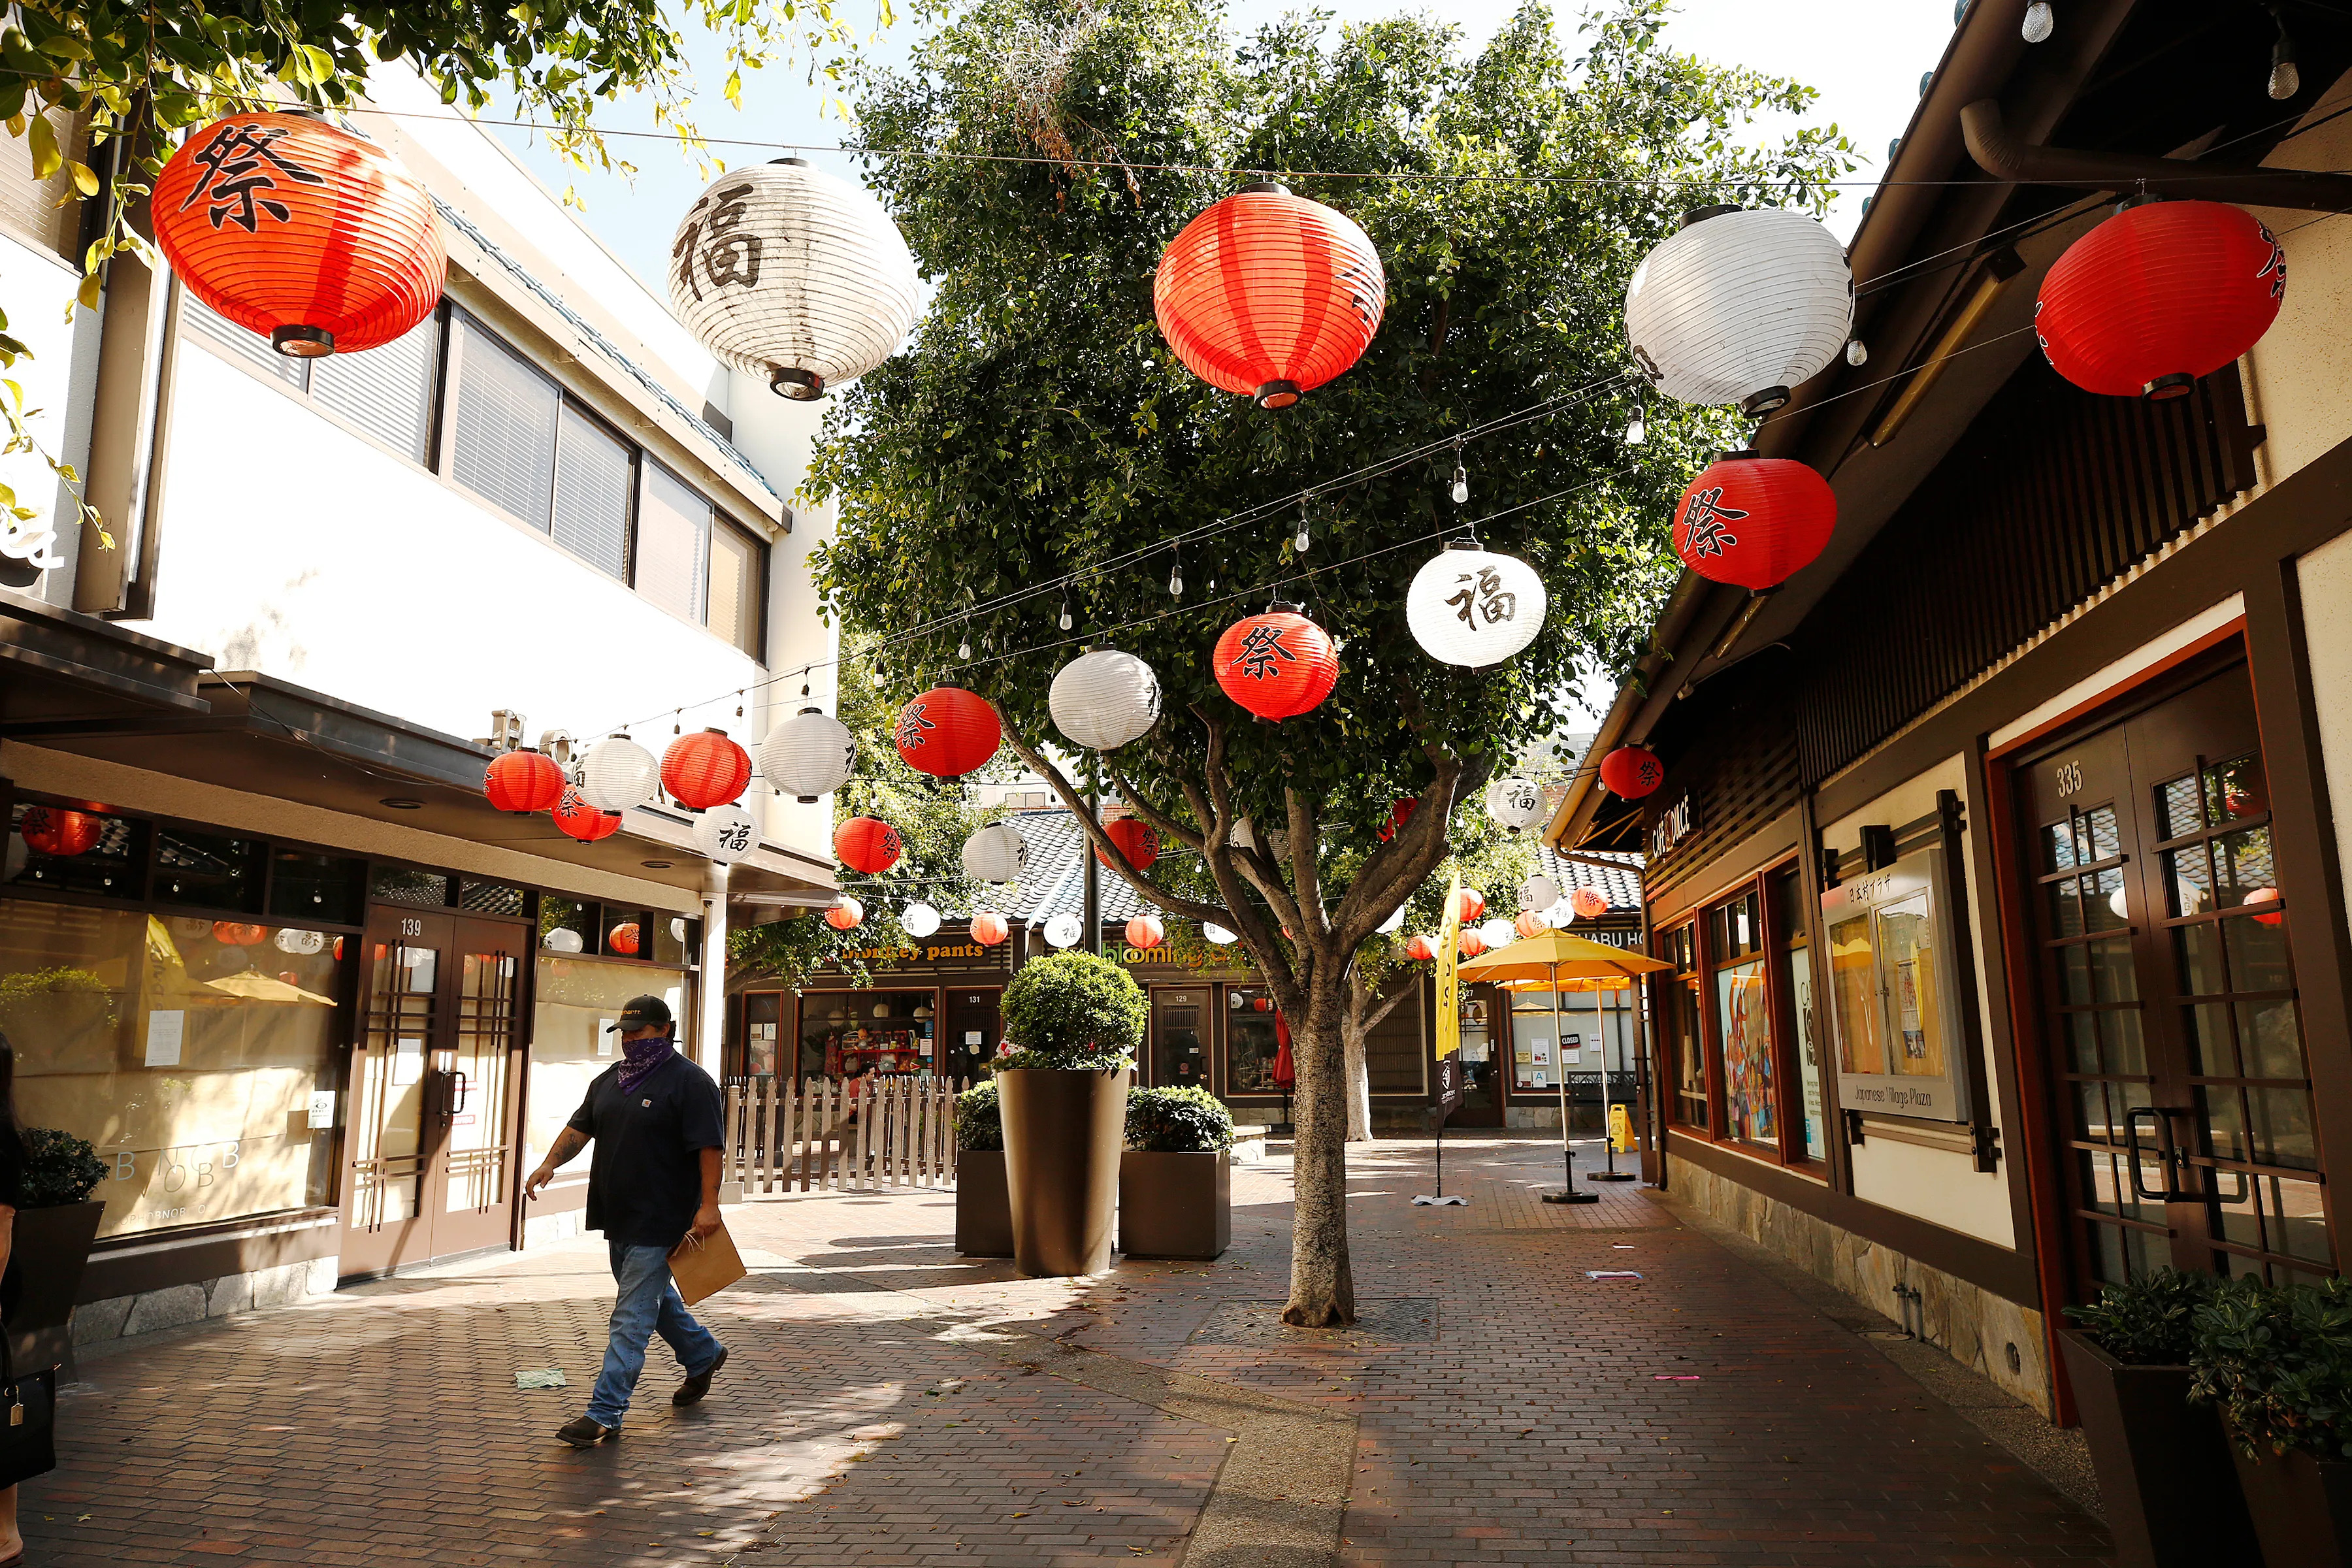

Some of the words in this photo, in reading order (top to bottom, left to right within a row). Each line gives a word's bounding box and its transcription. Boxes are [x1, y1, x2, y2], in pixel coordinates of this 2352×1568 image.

[179, 123, 325, 234] 祭
[673, 184, 762, 302] 福
[1683, 487, 1750, 558] 祭
[1444, 565, 1516, 631] 福
[1231, 625, 1296, 681] 祭
[897, 704, 936, 749] 祭
[1637, 761, 1660, 787] 祭
[2057, 760, 2082, 798] 335
[555, 789, 586, 819] 祭
[1506, 785, 1536, 811] 福
[719, 822, 751, 851] 福
[877, 831, 900, 860] 祭
[1137, 829, 1160, 857] 祭
[1518, 885, 1533, 902] 福
[1584, 890, 1599, 906] 祭
[400, 917, 421, 937] 139
[903, 913, 914, 930] 福
[1062, 923, 1077, 939] 福
[927, 943, 983, 961] pants
[1561, 1036, 1578, 1045] CLOSED
[1855, 1085, 1885, 1105] Japanese
[1910, 1088, 1931, 1106] Plaza
[116, 1141, 240, 1181] BNOB
